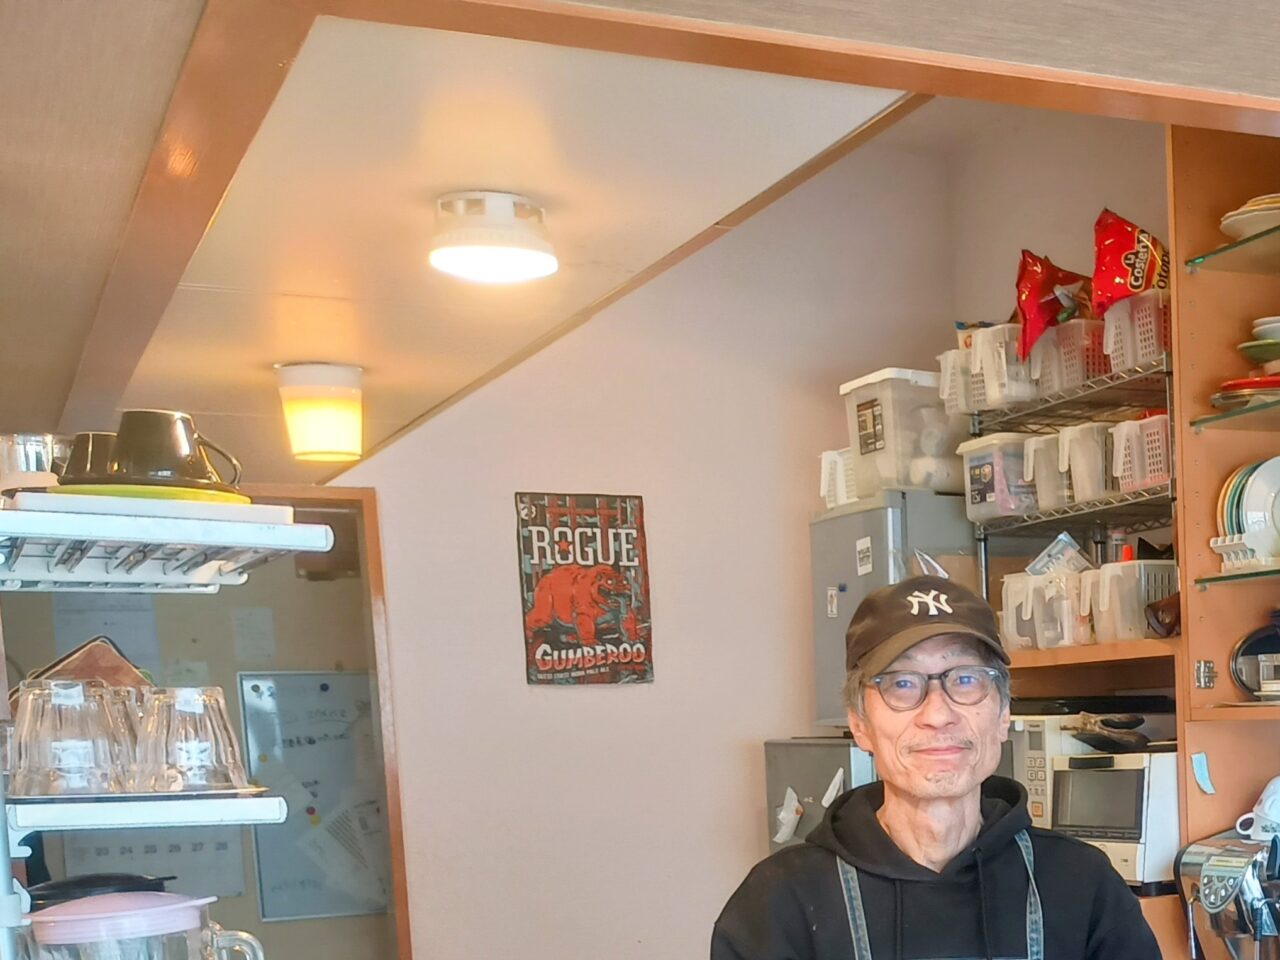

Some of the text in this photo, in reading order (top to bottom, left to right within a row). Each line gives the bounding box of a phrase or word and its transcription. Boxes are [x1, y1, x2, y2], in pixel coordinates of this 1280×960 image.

[527, 525, 639, 567] ROGUE
[906, 589, 954, 616] NY
[534, 642, 646, 671] GUMBEROO
